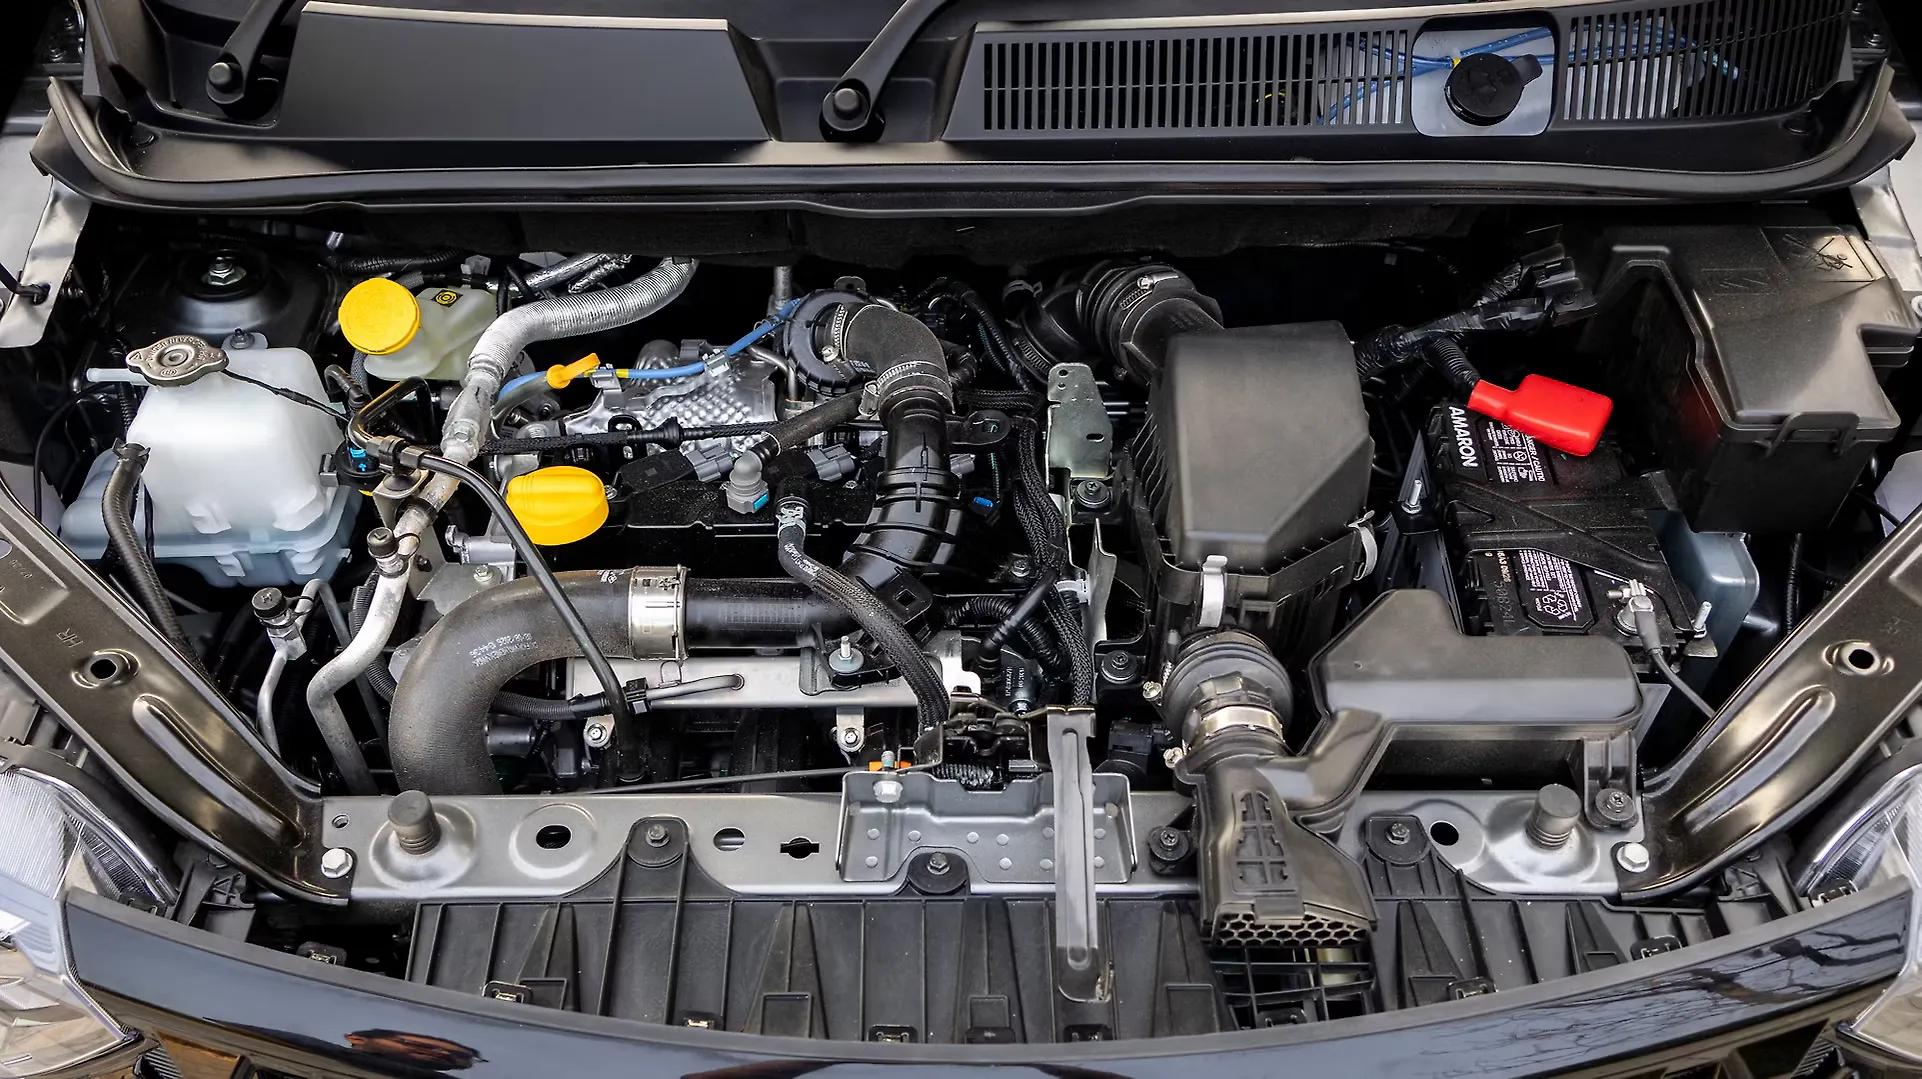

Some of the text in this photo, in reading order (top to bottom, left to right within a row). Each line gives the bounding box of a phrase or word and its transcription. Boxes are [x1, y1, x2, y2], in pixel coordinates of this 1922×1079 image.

[1448, 406, 1479, 467] AMARON
[1525, 434, 1538, 458] ANGER
[56, 627, 84, 648] HR
